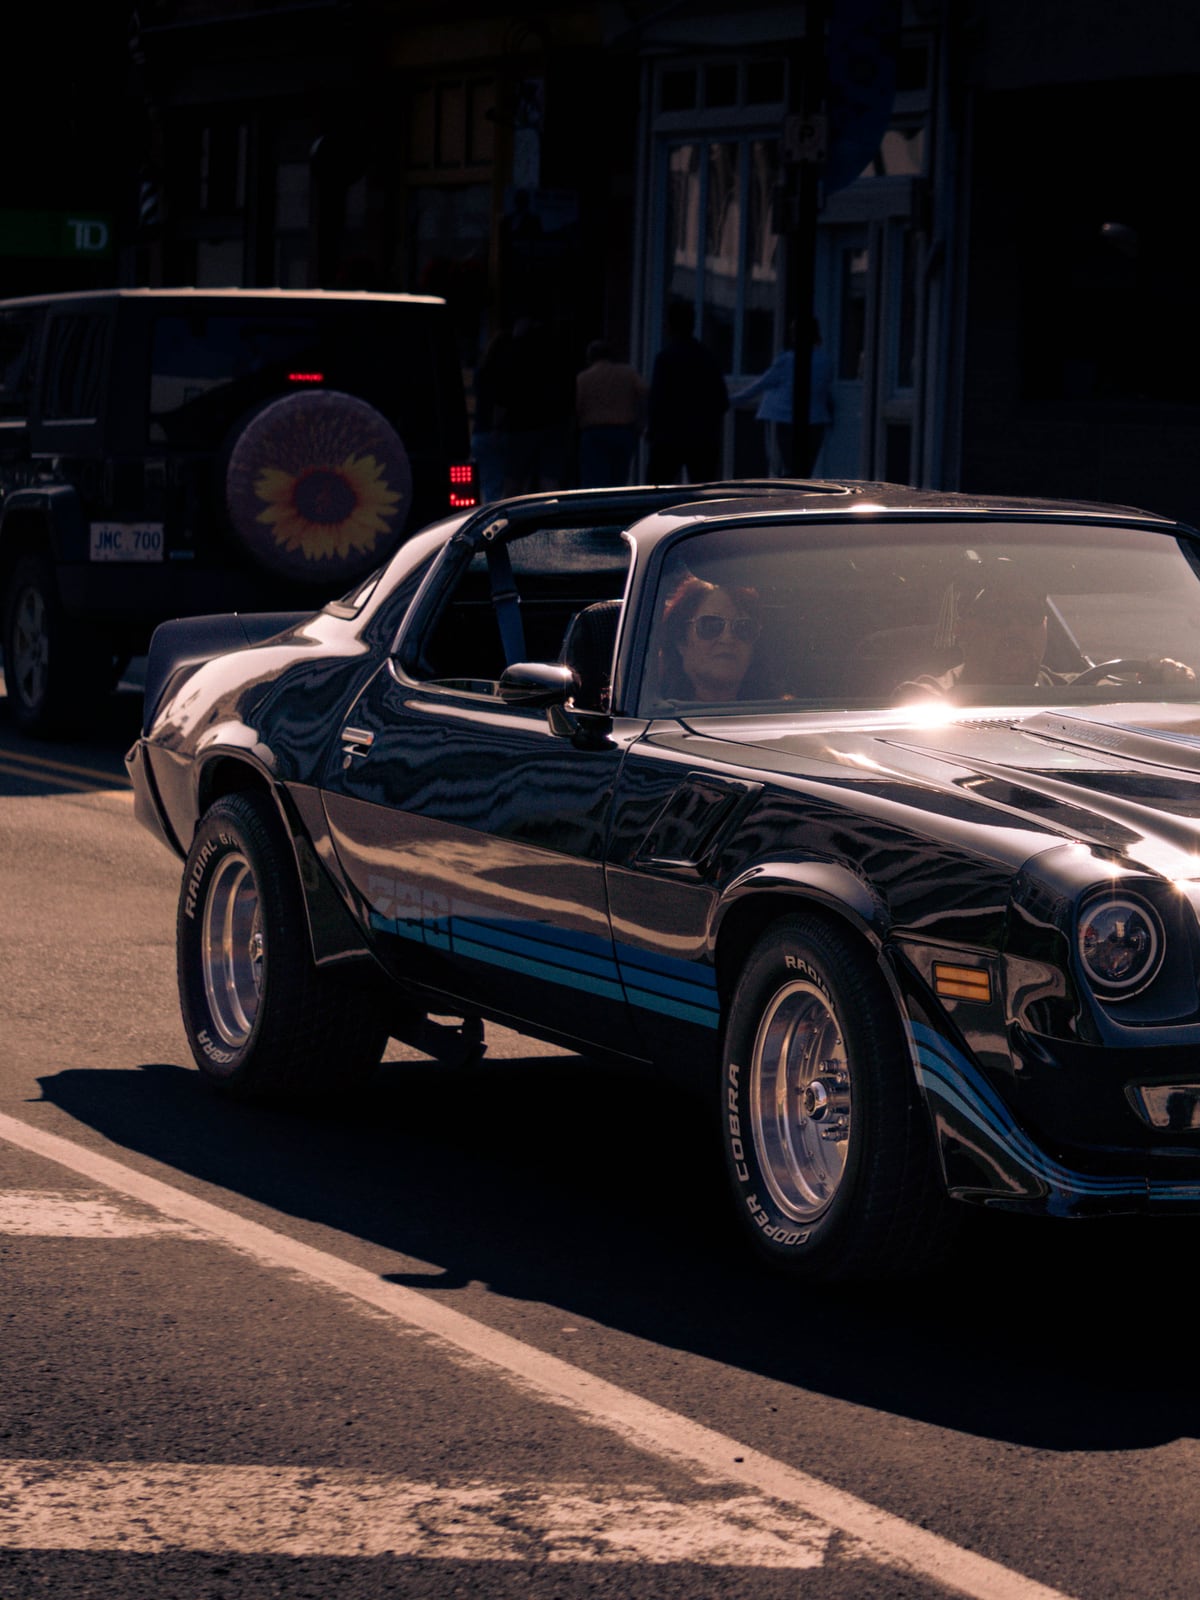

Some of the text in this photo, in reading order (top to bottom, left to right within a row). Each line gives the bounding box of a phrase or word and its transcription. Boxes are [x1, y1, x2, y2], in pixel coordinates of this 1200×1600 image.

[66, 218, 109, 251] TD
[95, 531, 160, 550] JMC 700
[185, 839, 218, 920] RADIAL
[728, 1063, 812, 1246] COOPER COBRA
